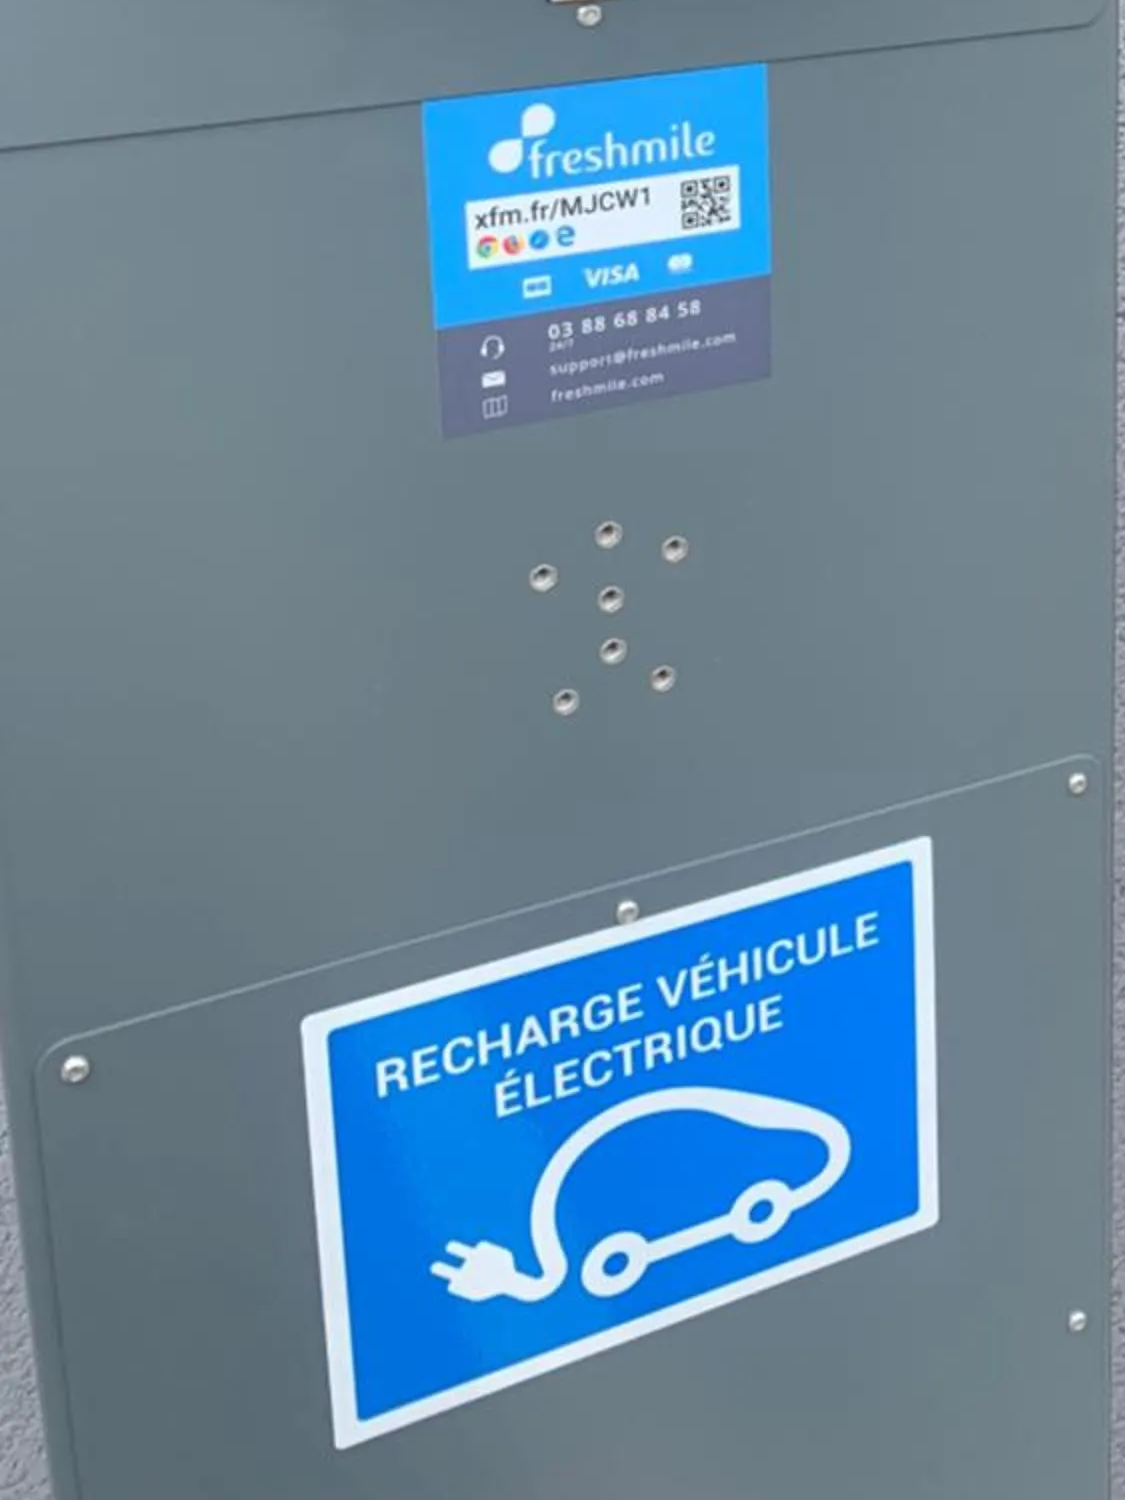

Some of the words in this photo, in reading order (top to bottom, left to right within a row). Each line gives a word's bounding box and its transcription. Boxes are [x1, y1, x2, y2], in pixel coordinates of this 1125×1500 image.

[528, 120, 717, 180] freshmile
[474, 186, 652, 231] xfm.fr/MJCW1
[584, 261, 641, 289] VISA
[548, 321, 574, 340] 03
[581, 315, 606, 335] 88
[613, 309, 639, 329] 68
[645, 304, 670, 323] 84
[677, 299, 702, 318] 58
[549, 331, 737, 377] support@freshmile.com
[551, 371, 665, 403] freshmile.com
[374, 982, 645, 1100] RECHARGE
[655, 911, 881, 1009] VÉHICULE
[493, 994, 784, 1119] ÉLECTRIQUE
